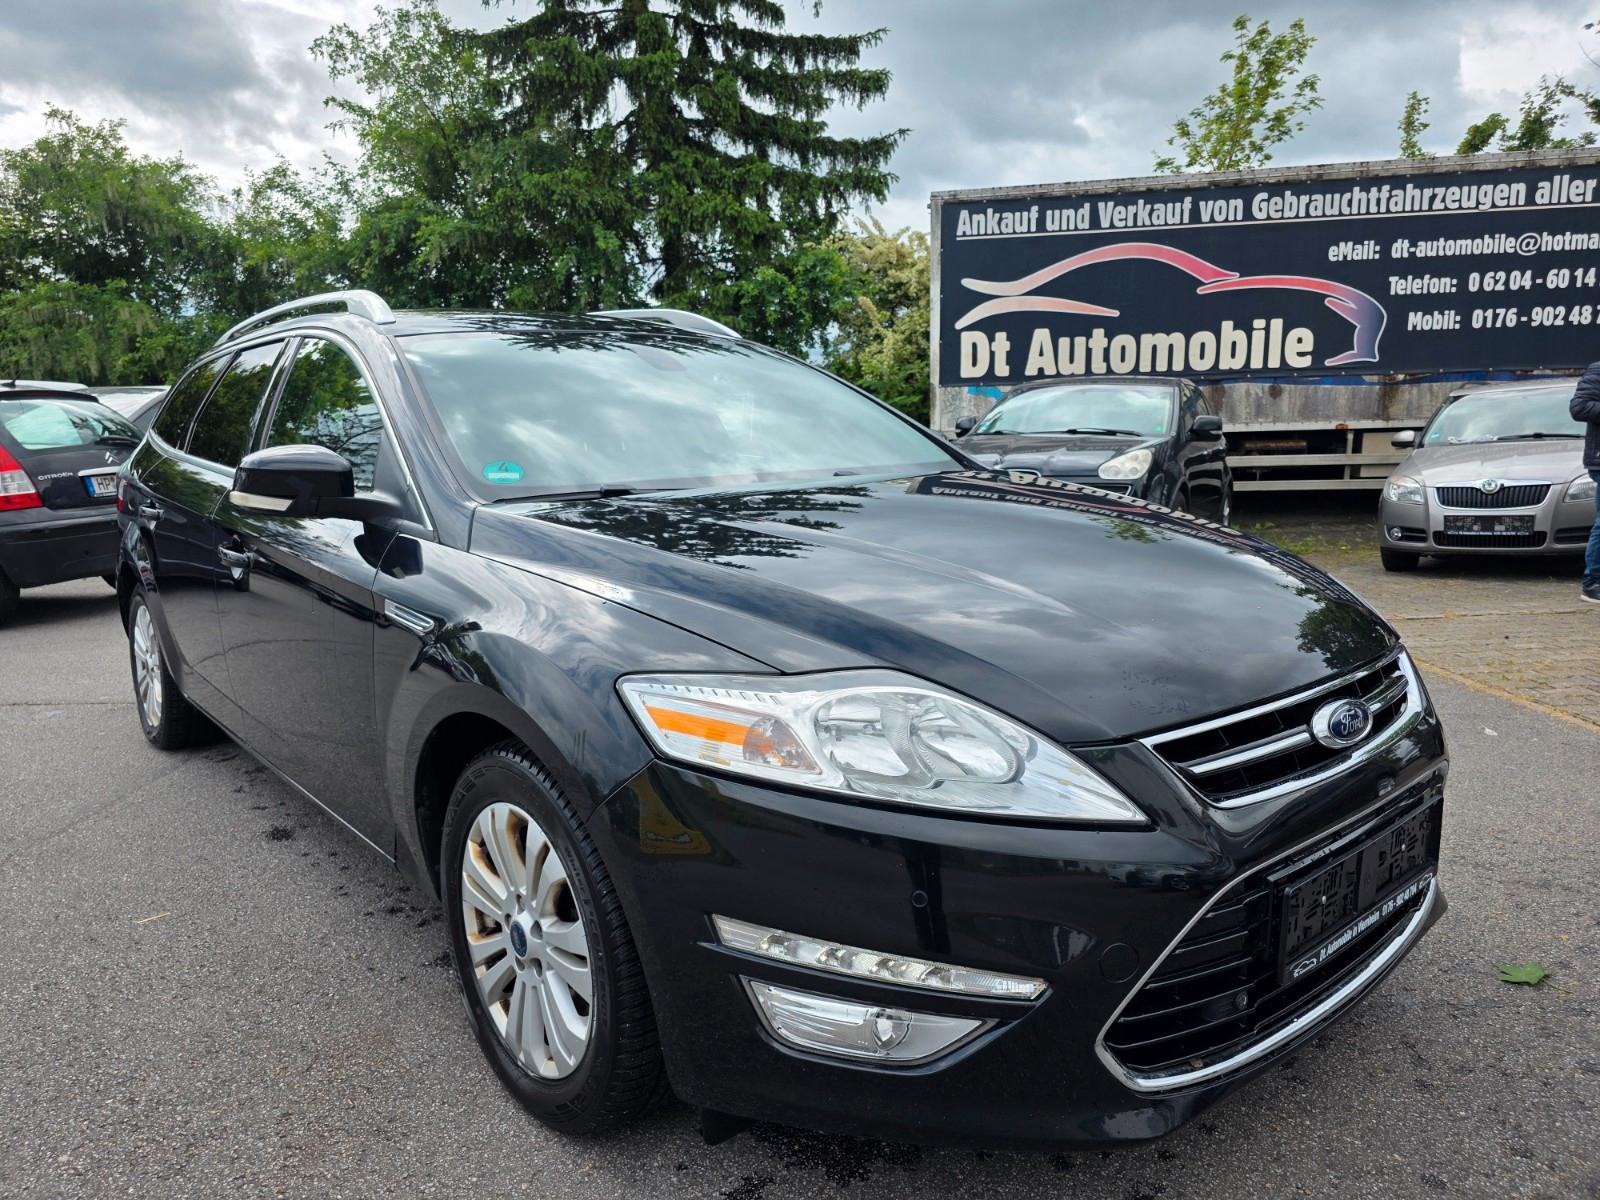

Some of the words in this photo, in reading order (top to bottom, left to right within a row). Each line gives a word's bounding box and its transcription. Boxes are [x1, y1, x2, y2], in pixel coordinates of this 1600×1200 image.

[956, 205, 1039, 236] Ankauf
[1045, 203, 1091, 231] und
[1098, 197, 1193, 229] Verkauf
[1199, 198, 1244, 223] von
[1251, 181, 1527, 220] Gebrauchtfahrzeugen
[1535, 174, 1597, 205] aller
[1328, 240, 1381, 262] eMail:
[1391, 232, 1600, 259] dt-automobile@hotma
[1389, 275, 1458, 295] Telefon:
[1407, 310, 1461, 331] Mobil:
[1471, 307, 1518, 329] 0176
[1531, 305, 1566, 327] 902
[1568, 305, 1593, 326] 48
[960, 331, 1012, 379] Dt
[1024, 318, 1315, 376] Automobile
[96, 477, 112, 491] HP
